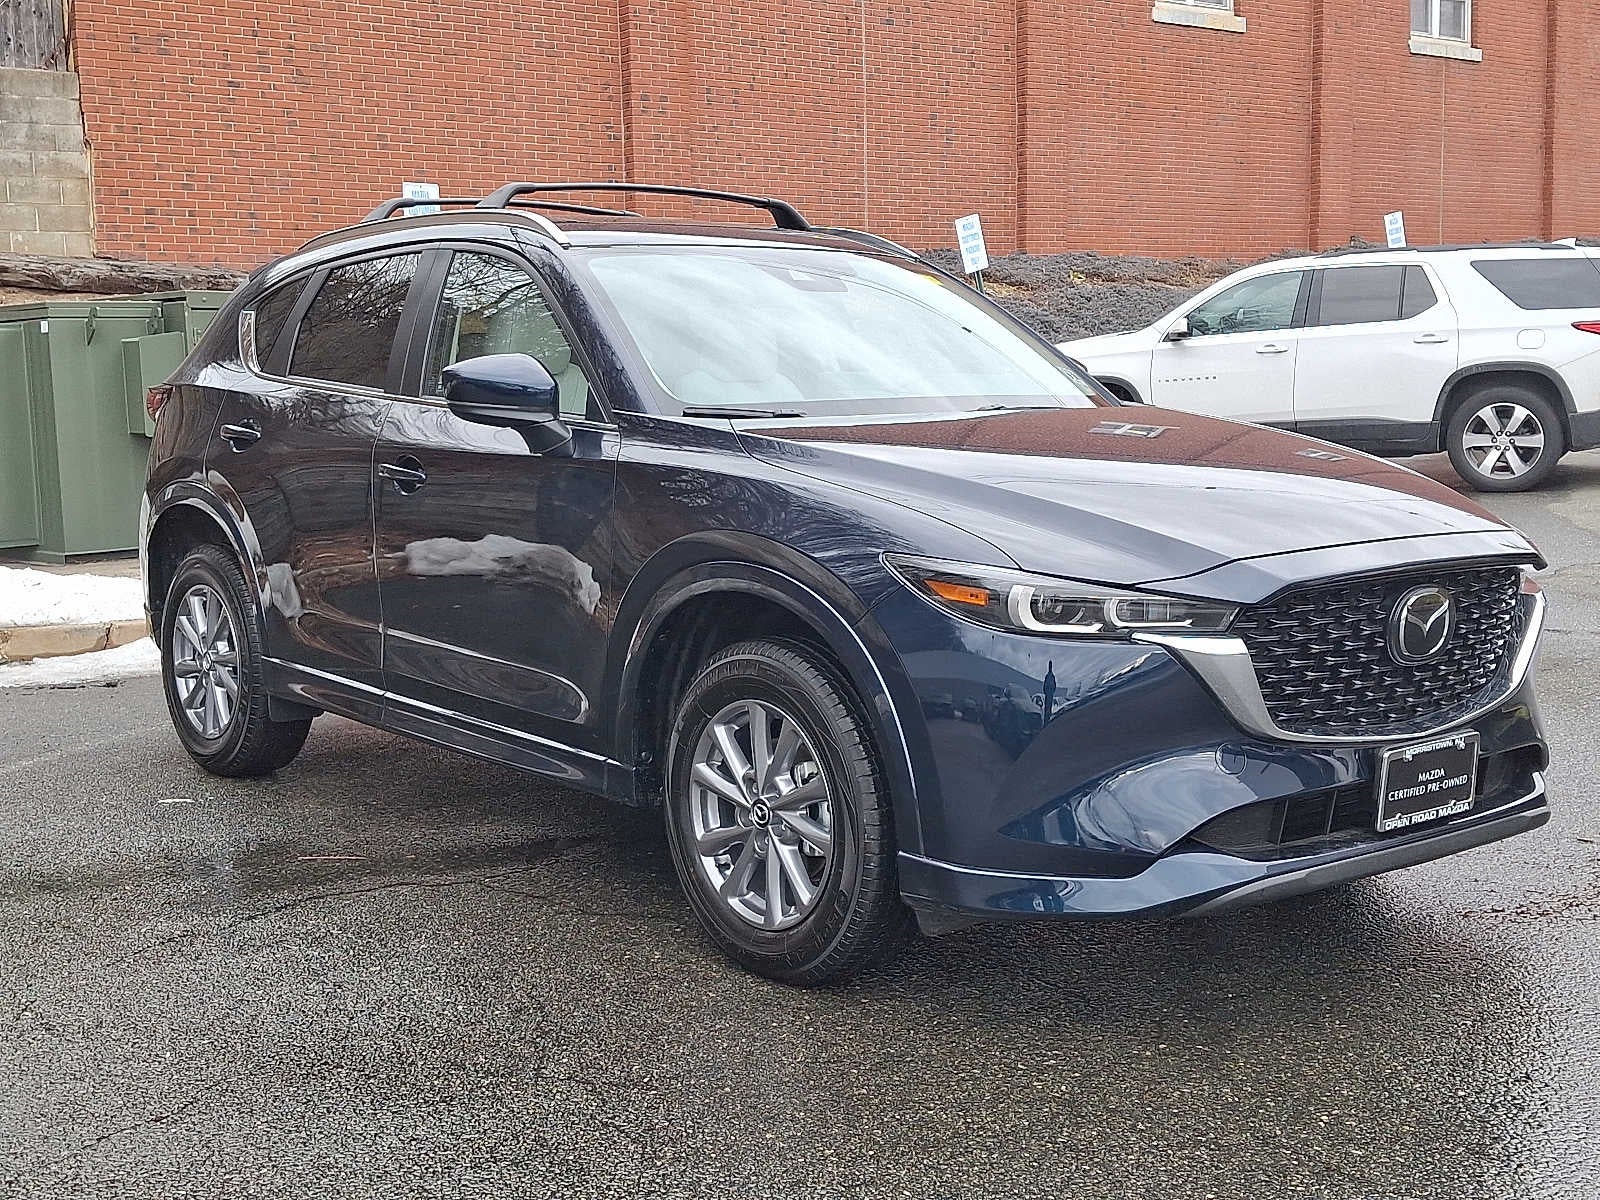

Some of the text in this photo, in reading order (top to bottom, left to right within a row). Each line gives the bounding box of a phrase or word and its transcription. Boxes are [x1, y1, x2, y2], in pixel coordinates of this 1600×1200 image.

[1388, 775, 1468, 802] CERTIFIED PRE-OWNED
[1418, 768, 1445, 782] MAZDA
[1385, 803, 1470, 831] OPEN ROAD MAZDA
